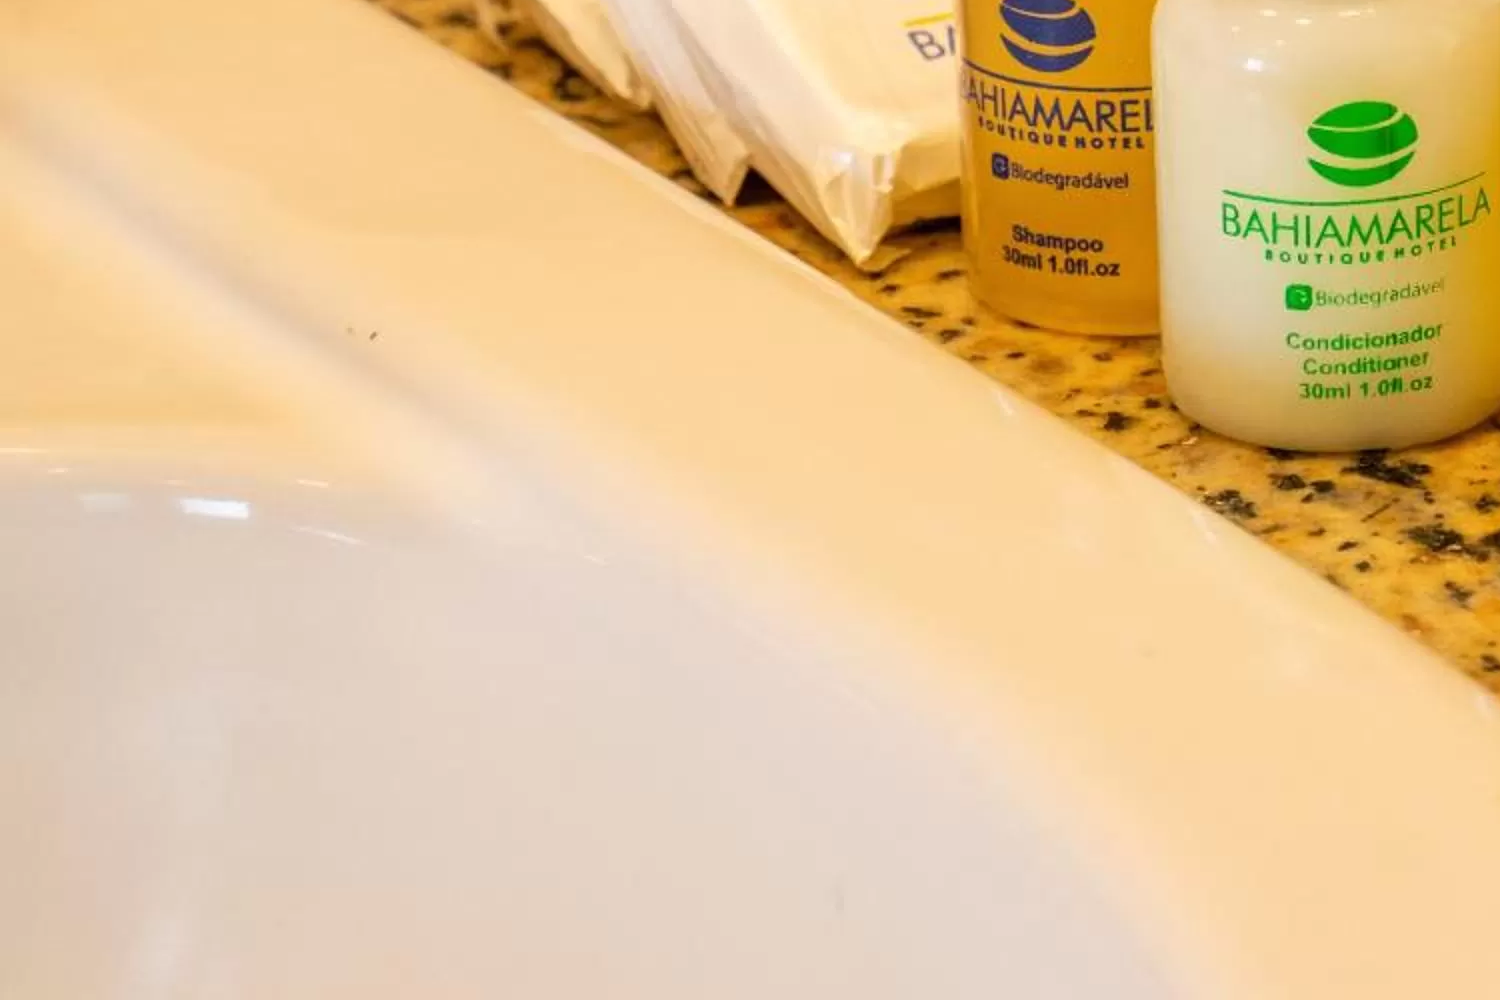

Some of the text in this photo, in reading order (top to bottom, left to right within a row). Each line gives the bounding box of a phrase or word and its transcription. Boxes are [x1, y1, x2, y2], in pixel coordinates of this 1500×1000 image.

[978, 115, 1145, 149] BOUTIQUE HOTEL
[1011, 162, 1129, 190] Biodegradável
[1222, 187, 1491, 248] BAHIAMARELA
[1012, 225, 1103, 254] Shampoo
[1265, 235, 1457, 265] BOUTIQUE HOTEL
[1002, 245, 1042, 270] 30ml
[1316, 277, 1445, 307] Biodegradável
[1286, 324, 1442, 350] Condicionador
[1303, 352, 1429, 375] Conditioner
[1299, 383, 1351, 399] 30ml
